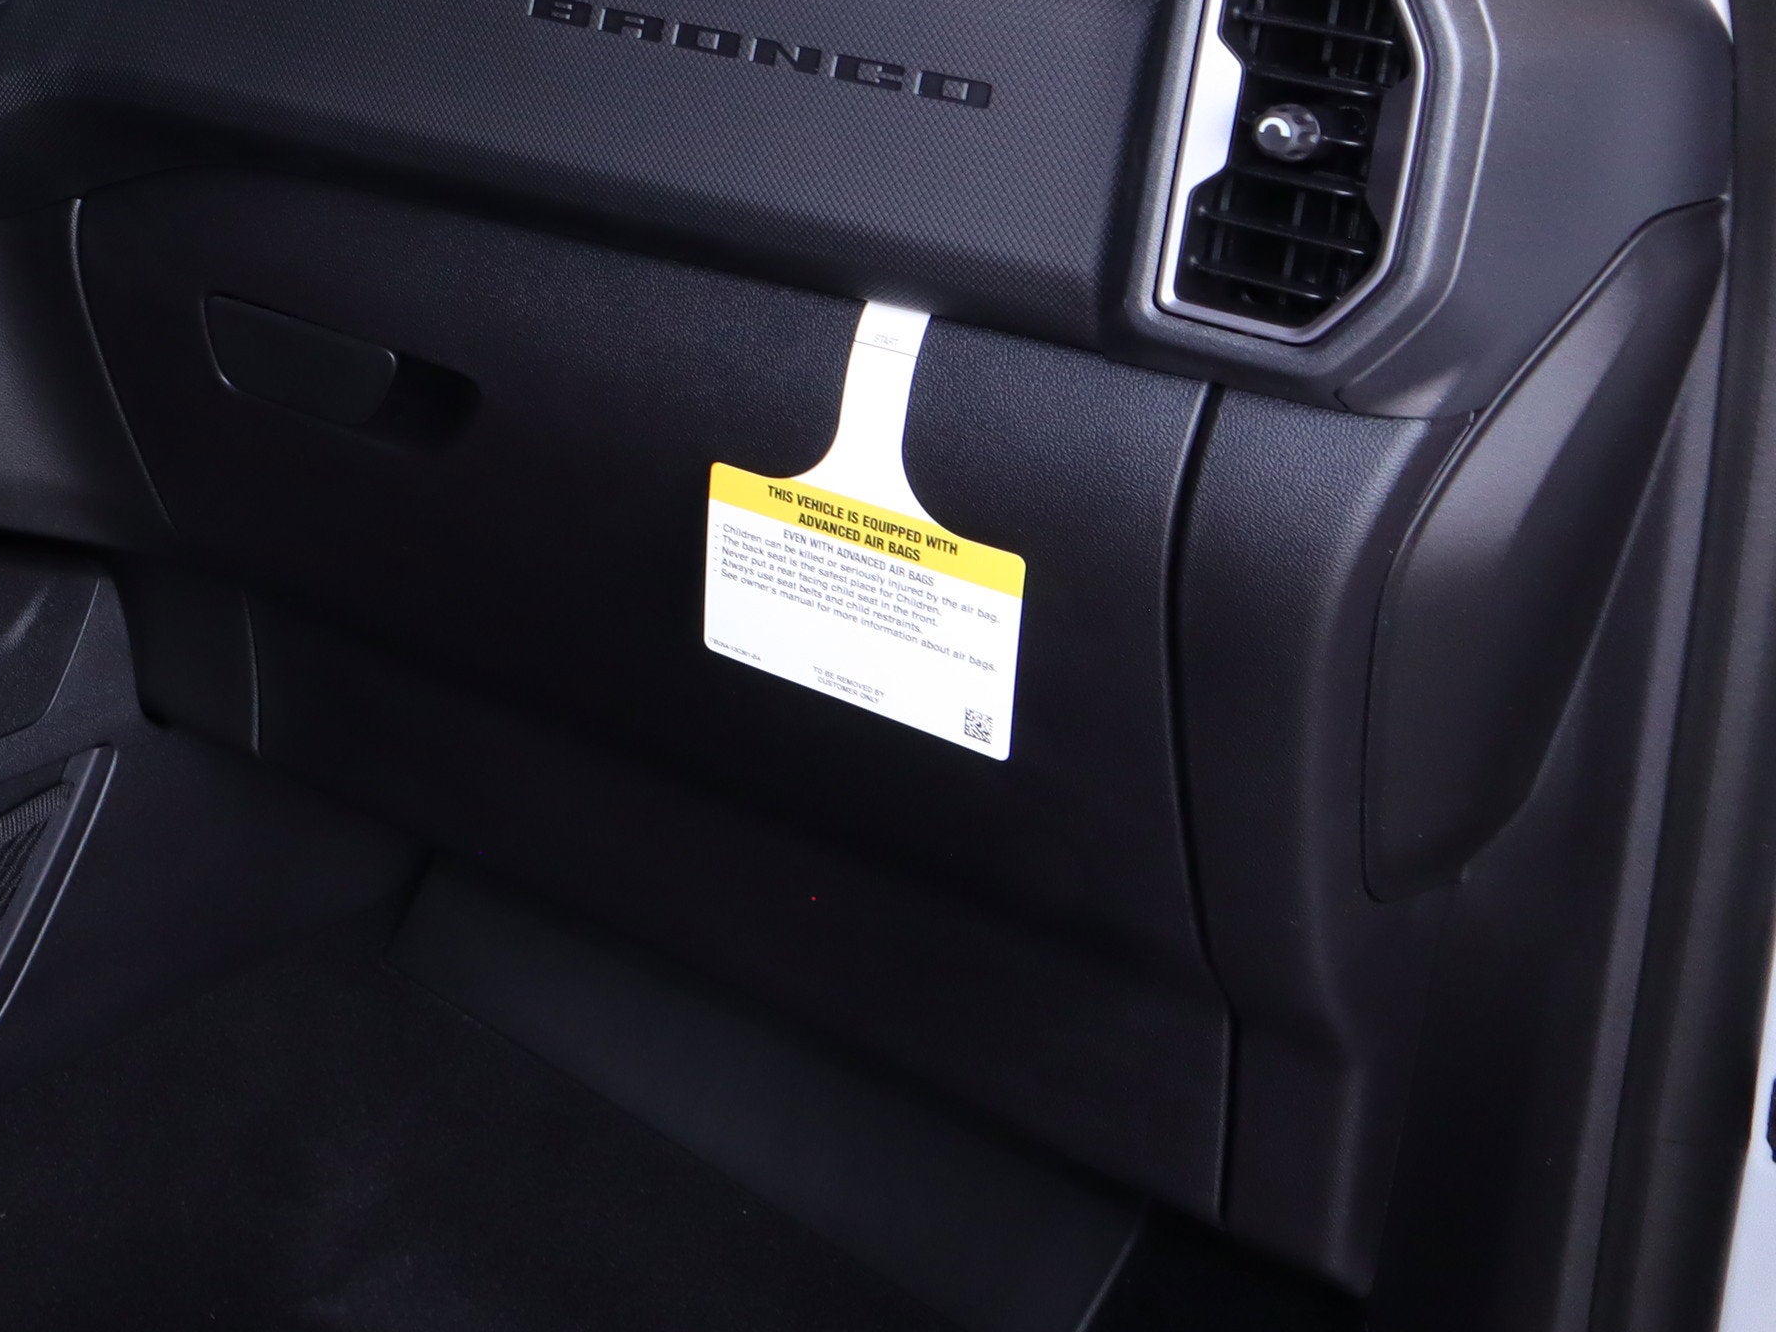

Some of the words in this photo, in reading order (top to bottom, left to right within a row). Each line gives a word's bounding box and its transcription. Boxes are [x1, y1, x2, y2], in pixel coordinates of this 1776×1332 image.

[768, 484, 794, 504] THIS
[796, 494, 844, 520] VEHICLE
[848, 510, 859, 524] IS
[862, 515, 922, 544] EQUIPPED
[926, 534, 958, 556] WITH
[798, 513, 861, 542] ADVANCED
[864, 534, 884, 550] AIR
[888, 540, 921, 562] BAGS
[721, 546, 749, 562] Never
[751, 557, 767, 569] put
[777, 566, 796, 578] rear
[799, 572, 828, 591] facing
[831, 584, 855, 598] child
[858, 592, 878, 607] seat
[881, 598, 890, 611] in
[893, 604, 909, 617] the
[911, 610, 939, 627] front.
[722, 534, 740, 547] The
[742, 542, 764, 556] back
[767, 551, 787, 564] seat
[790, 557, 798, 567] is
[800, 561, 815, 573] the
[818, 567, 848, 584] safest
[850, 579, 877, 593] place
[879, 588, 893, 598] for
[896, 593, 942, 616] Children.
[723, 524, 762, 544] Children
[764, 539, 781, 549] can
[784, 544, 796, 554] be
[799, 548, 824, 564] killed
[827, 559, 837, 567] or
[840, 564, 885, 585] seriously
[888, 579, 923, 598] injured
[926, 592, 939, 604] by
[942, 596, 958, 608] the
[961, 604, 974, 614] air
[977, 609, 1000, 624] bag.
[784, 529, 807, 545] EVEN
[810, 537, 834, 554] WITH
[836, 547, 886, 571] ADVANCED
[889, 564, 905, 578] AIR
[908, 570, 934, 586] BAGS
[721, 558, 755, 576] Always
[757, 571, 774, 582] use
[777, 577, 797, 590] seat
[799, 584, 823, 599] belts
[825, 593, 843, 606] and
[846, 601, 870, 615] child
[873, 611, 924, 634] restraints.
[721, 568, 738, 582] See
[740, 576, 777, 595] owner's
[779, 589, 815, 608] manual
[817, 602, 831, 612] for
[833, 609, 858, 623] more
[860, 619, 918, 644] information
[921, 639, 950, 656] about
[953, 650, 966, 661] air
[968, 655, 997, 672] bags.
[813, 665, 823, 675] TO
[824, 670, 835, 679] BE
[836, 674, 873, 693] REMOVED
[874, 688, 885, 698] BY
[817, 676, 859, 696] CUSTOMER
[859, 692, 880, 704] ONLY
